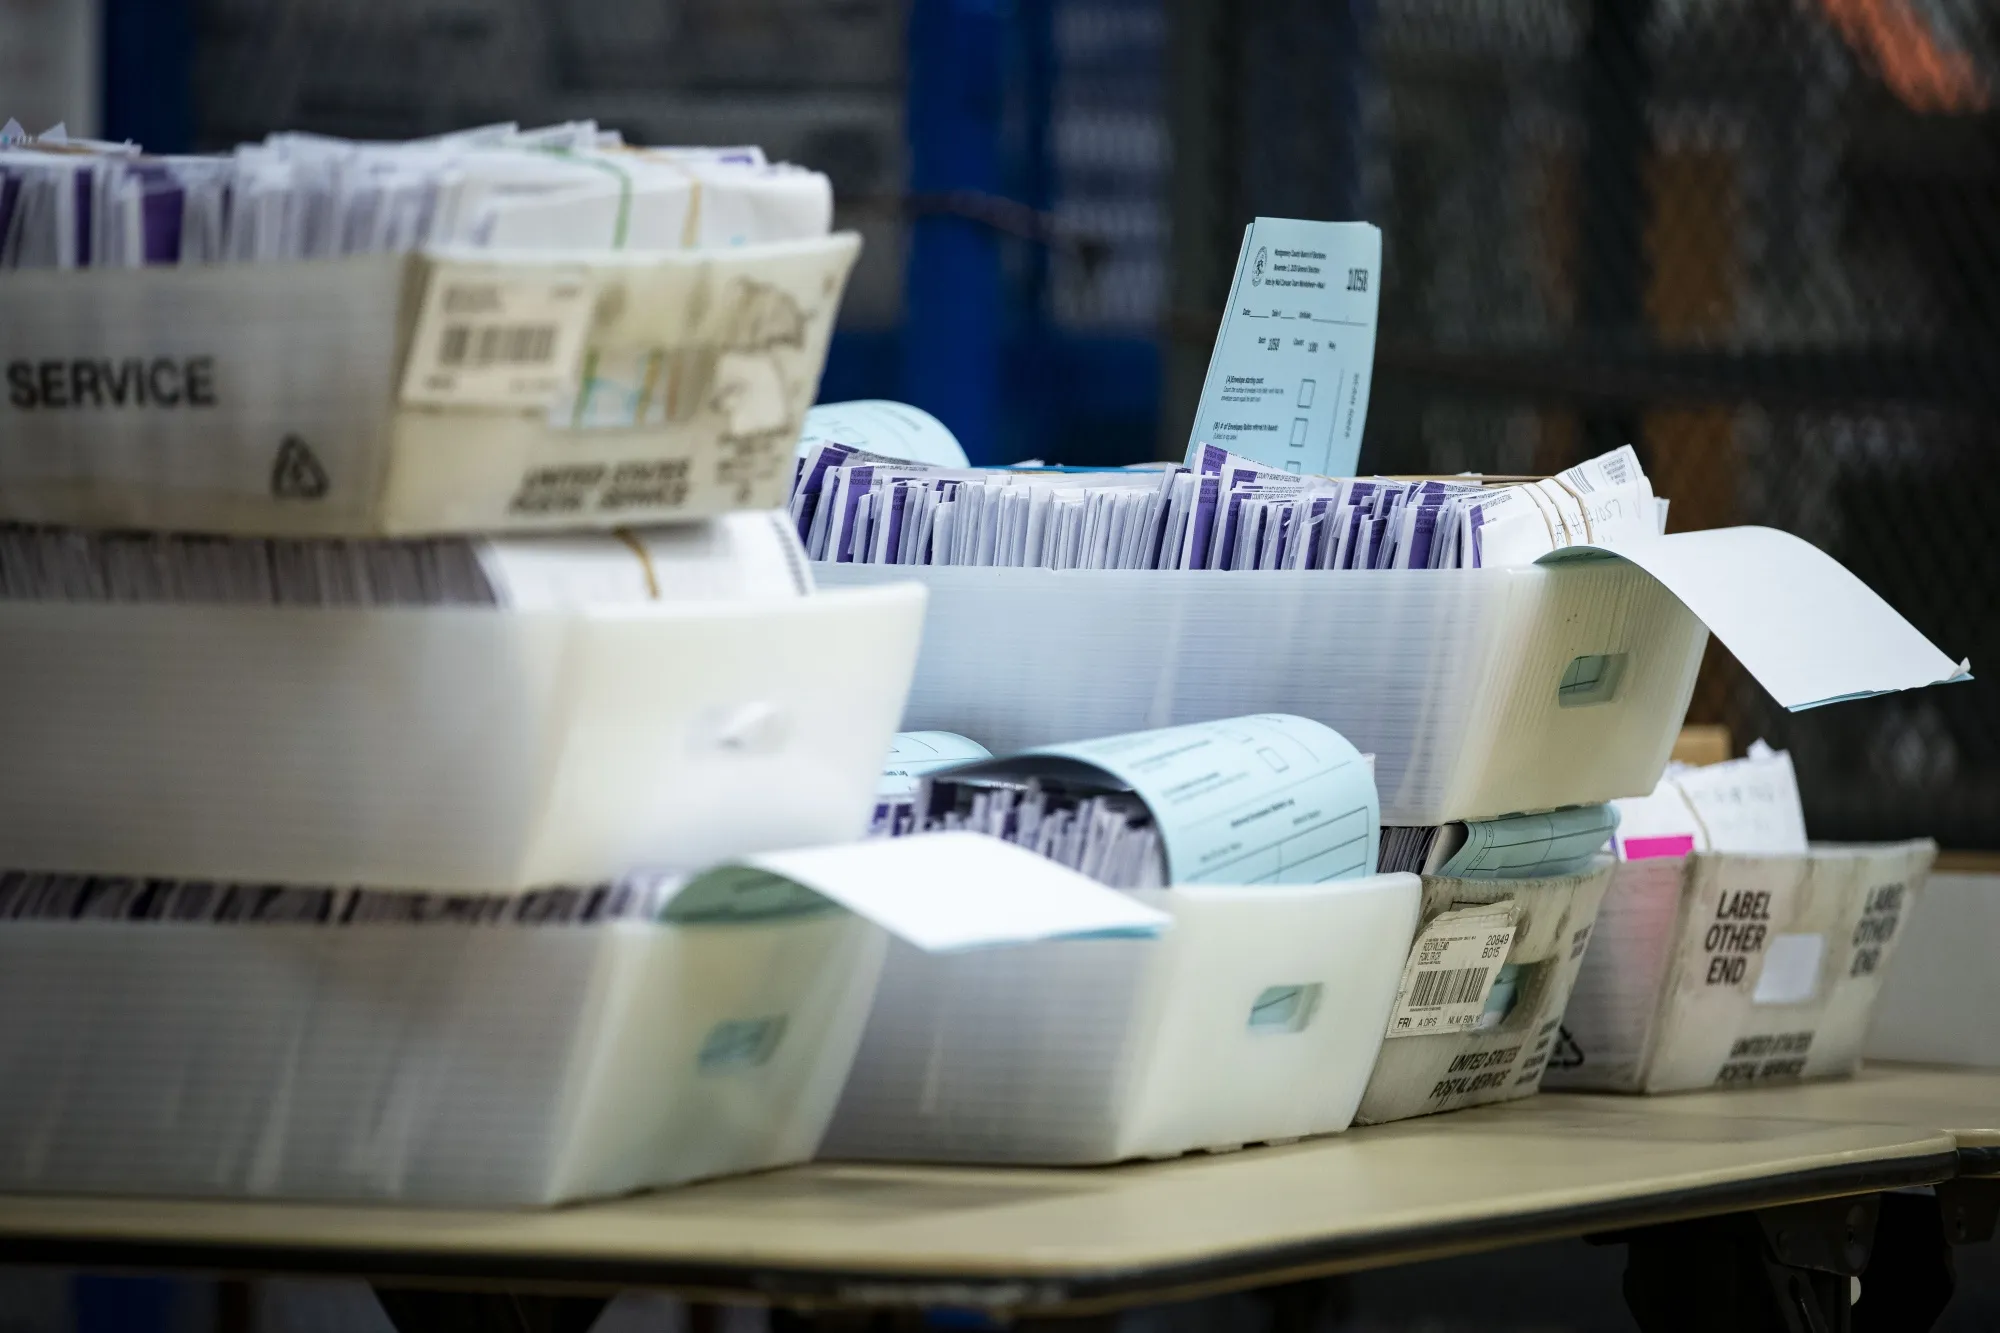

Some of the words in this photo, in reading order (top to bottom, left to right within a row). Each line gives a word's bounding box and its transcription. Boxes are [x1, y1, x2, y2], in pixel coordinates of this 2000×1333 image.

[7, 357, 218, 410] SERVICE
[1717, 890, 1772, 920] LABEL
[1486, 934, 1510, 946] 20849
[1705, 924, 1767, 952] OTHER
[1482, 947, 1501, 959] B015
[1706, 957, 1747, 986] END
[1397, 1017, 1412, 1028] FRI
[1448, 1051, 1489, 1073] UNITED
[1429, 1076, 1472, 1099] POSTAL
